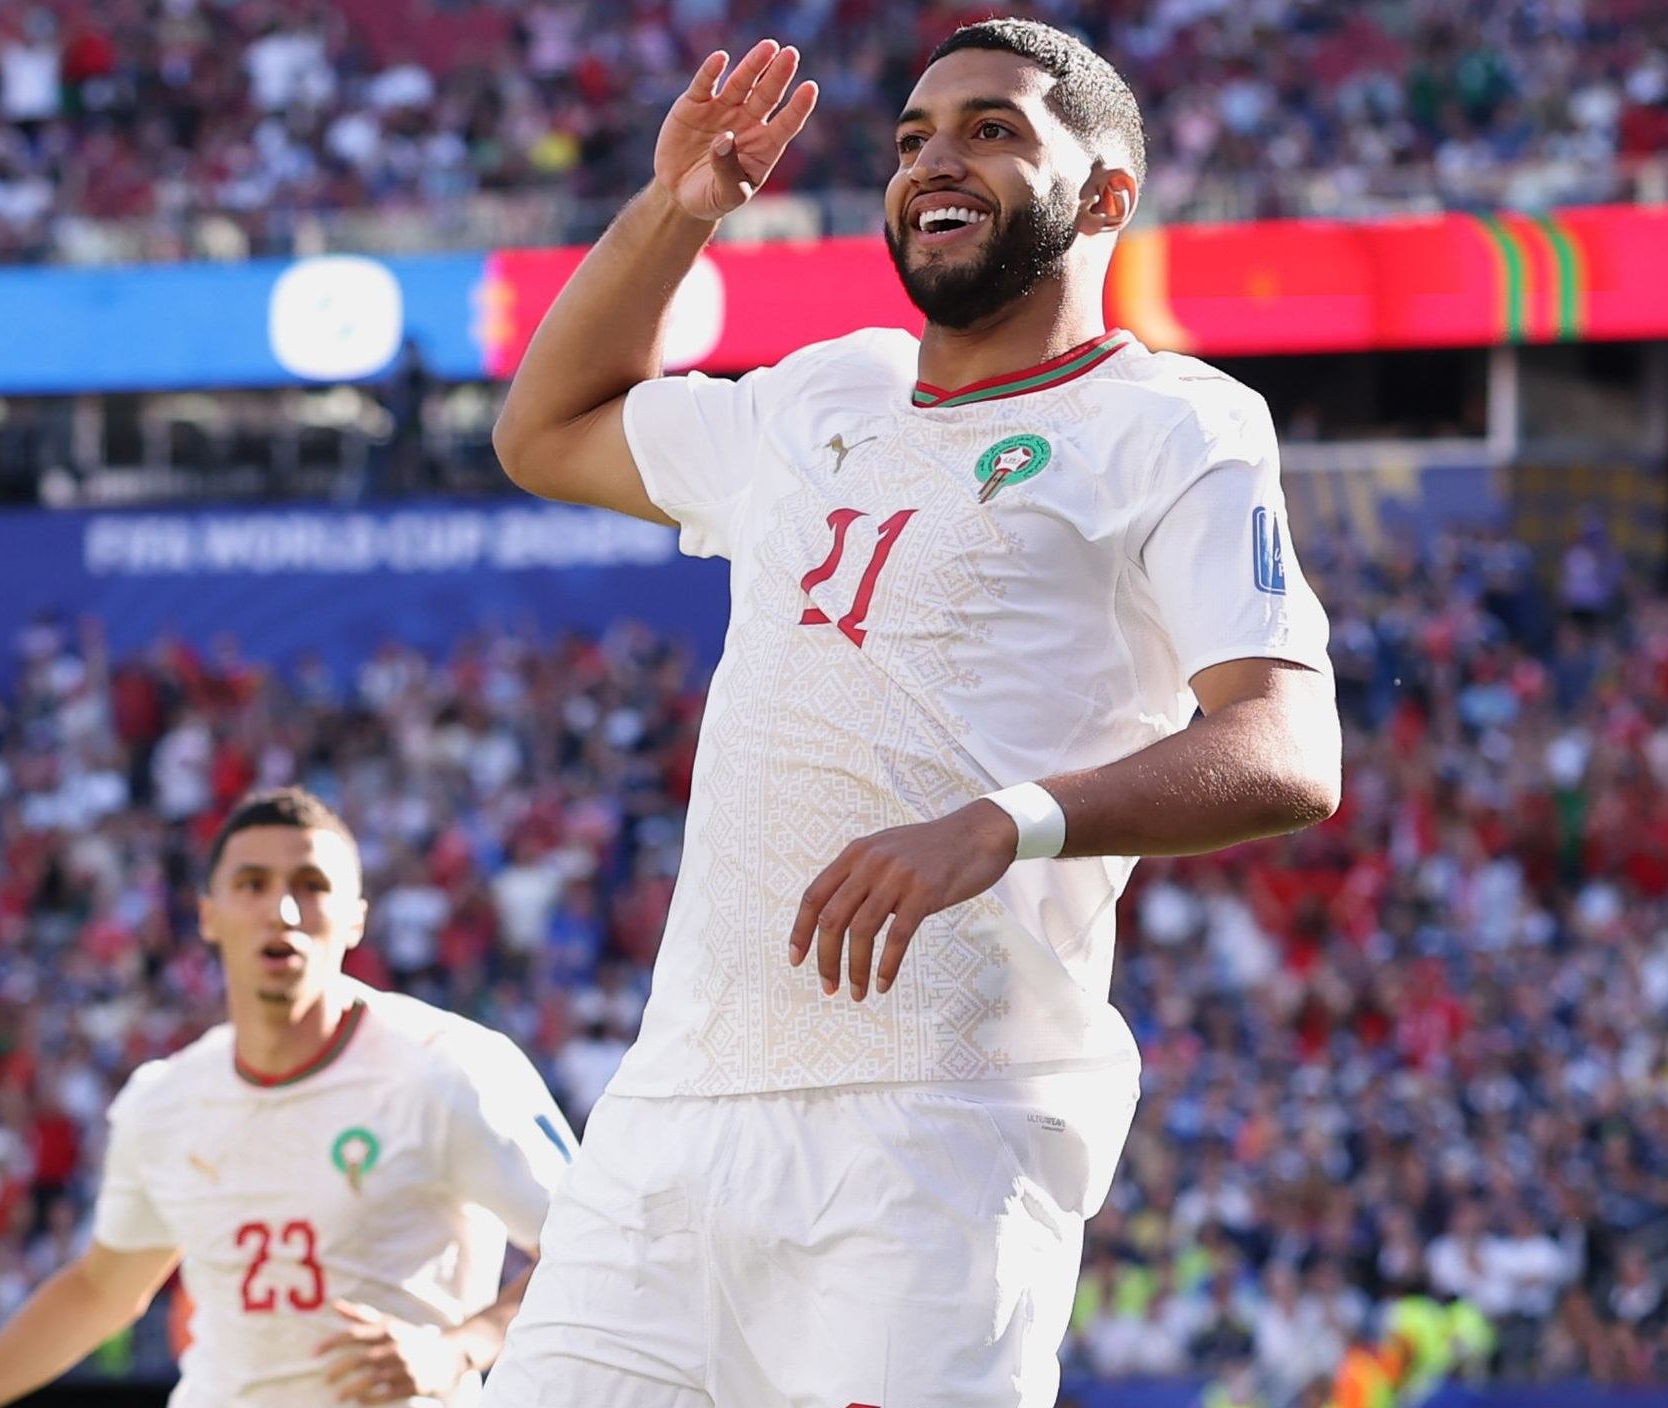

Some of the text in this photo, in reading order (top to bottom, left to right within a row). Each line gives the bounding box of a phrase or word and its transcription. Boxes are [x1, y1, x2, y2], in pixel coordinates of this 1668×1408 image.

[386, 511, 482, 569] CUP
[798, 508, 920, 649] 11
[236, 1221, 325, 1311] 23
